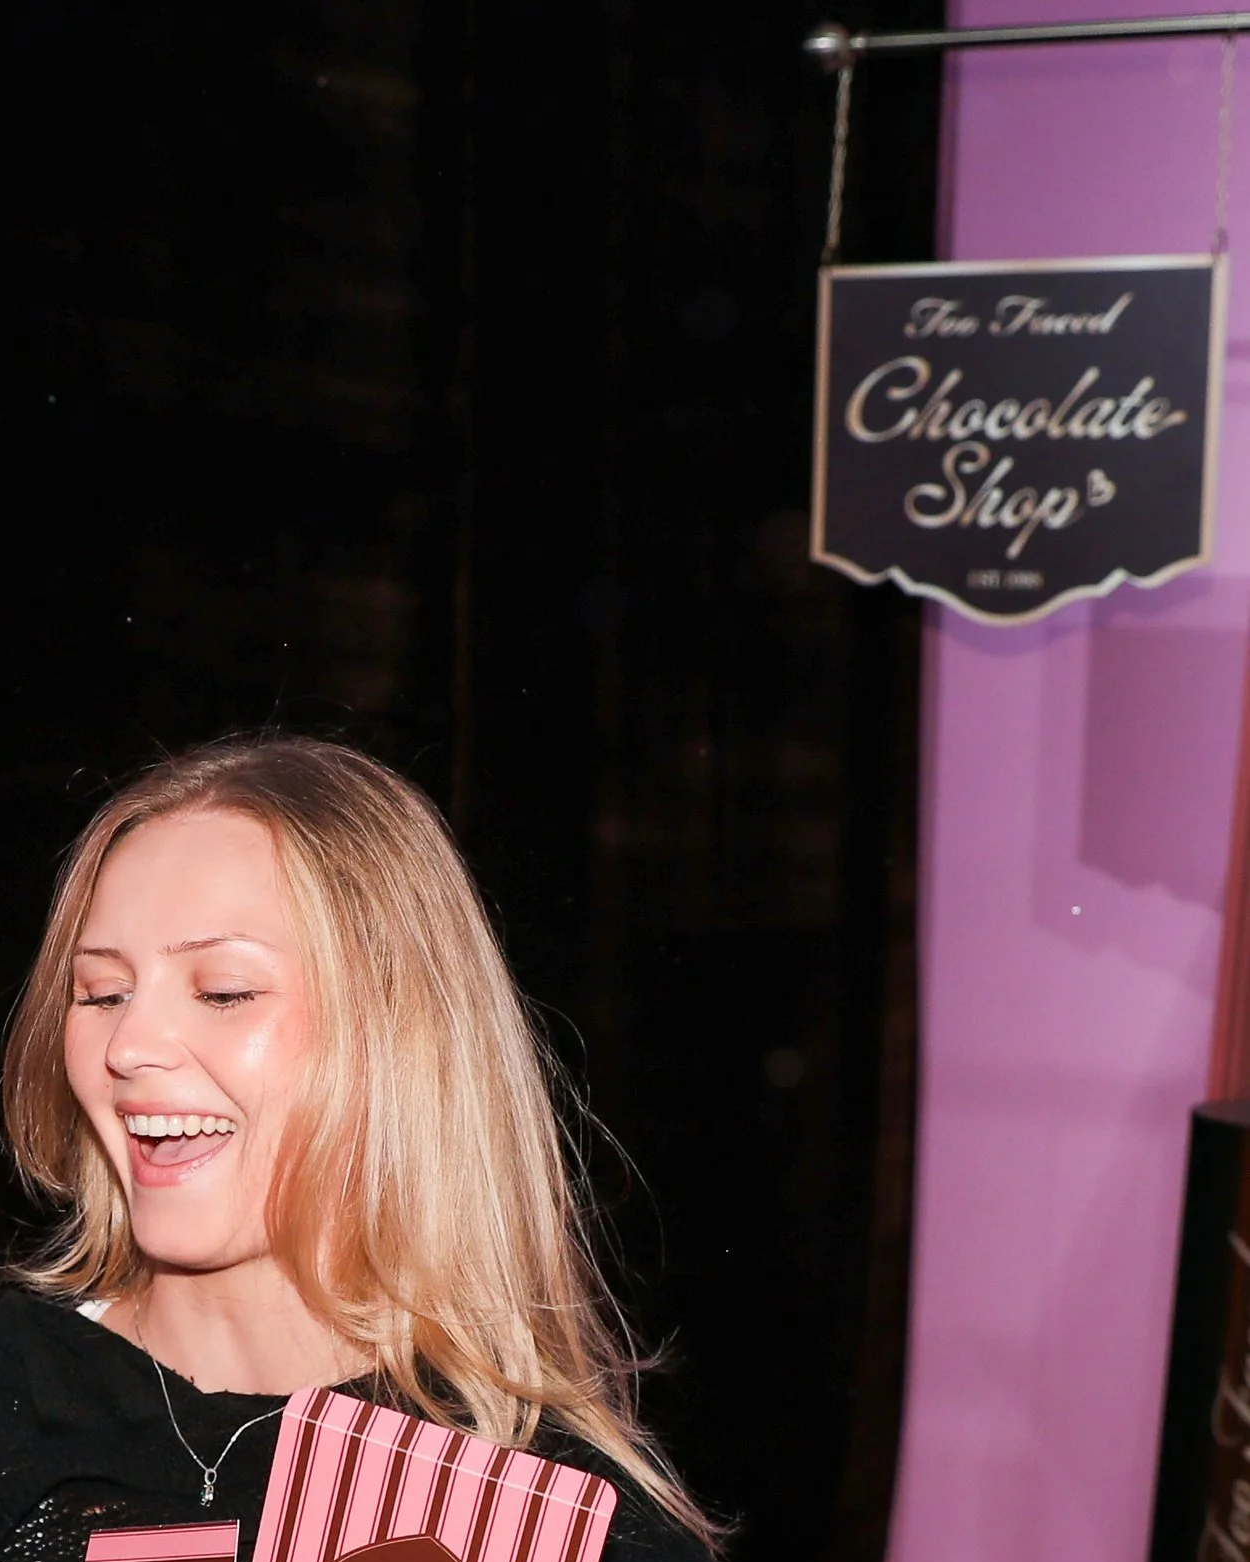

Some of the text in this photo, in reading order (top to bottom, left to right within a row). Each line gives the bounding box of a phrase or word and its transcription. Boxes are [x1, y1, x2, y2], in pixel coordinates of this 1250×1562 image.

[903, 296, 980, 339] Too
[845, 356, 1188, 443] Chocolate
[903, 440, 1082, 560] Shop
